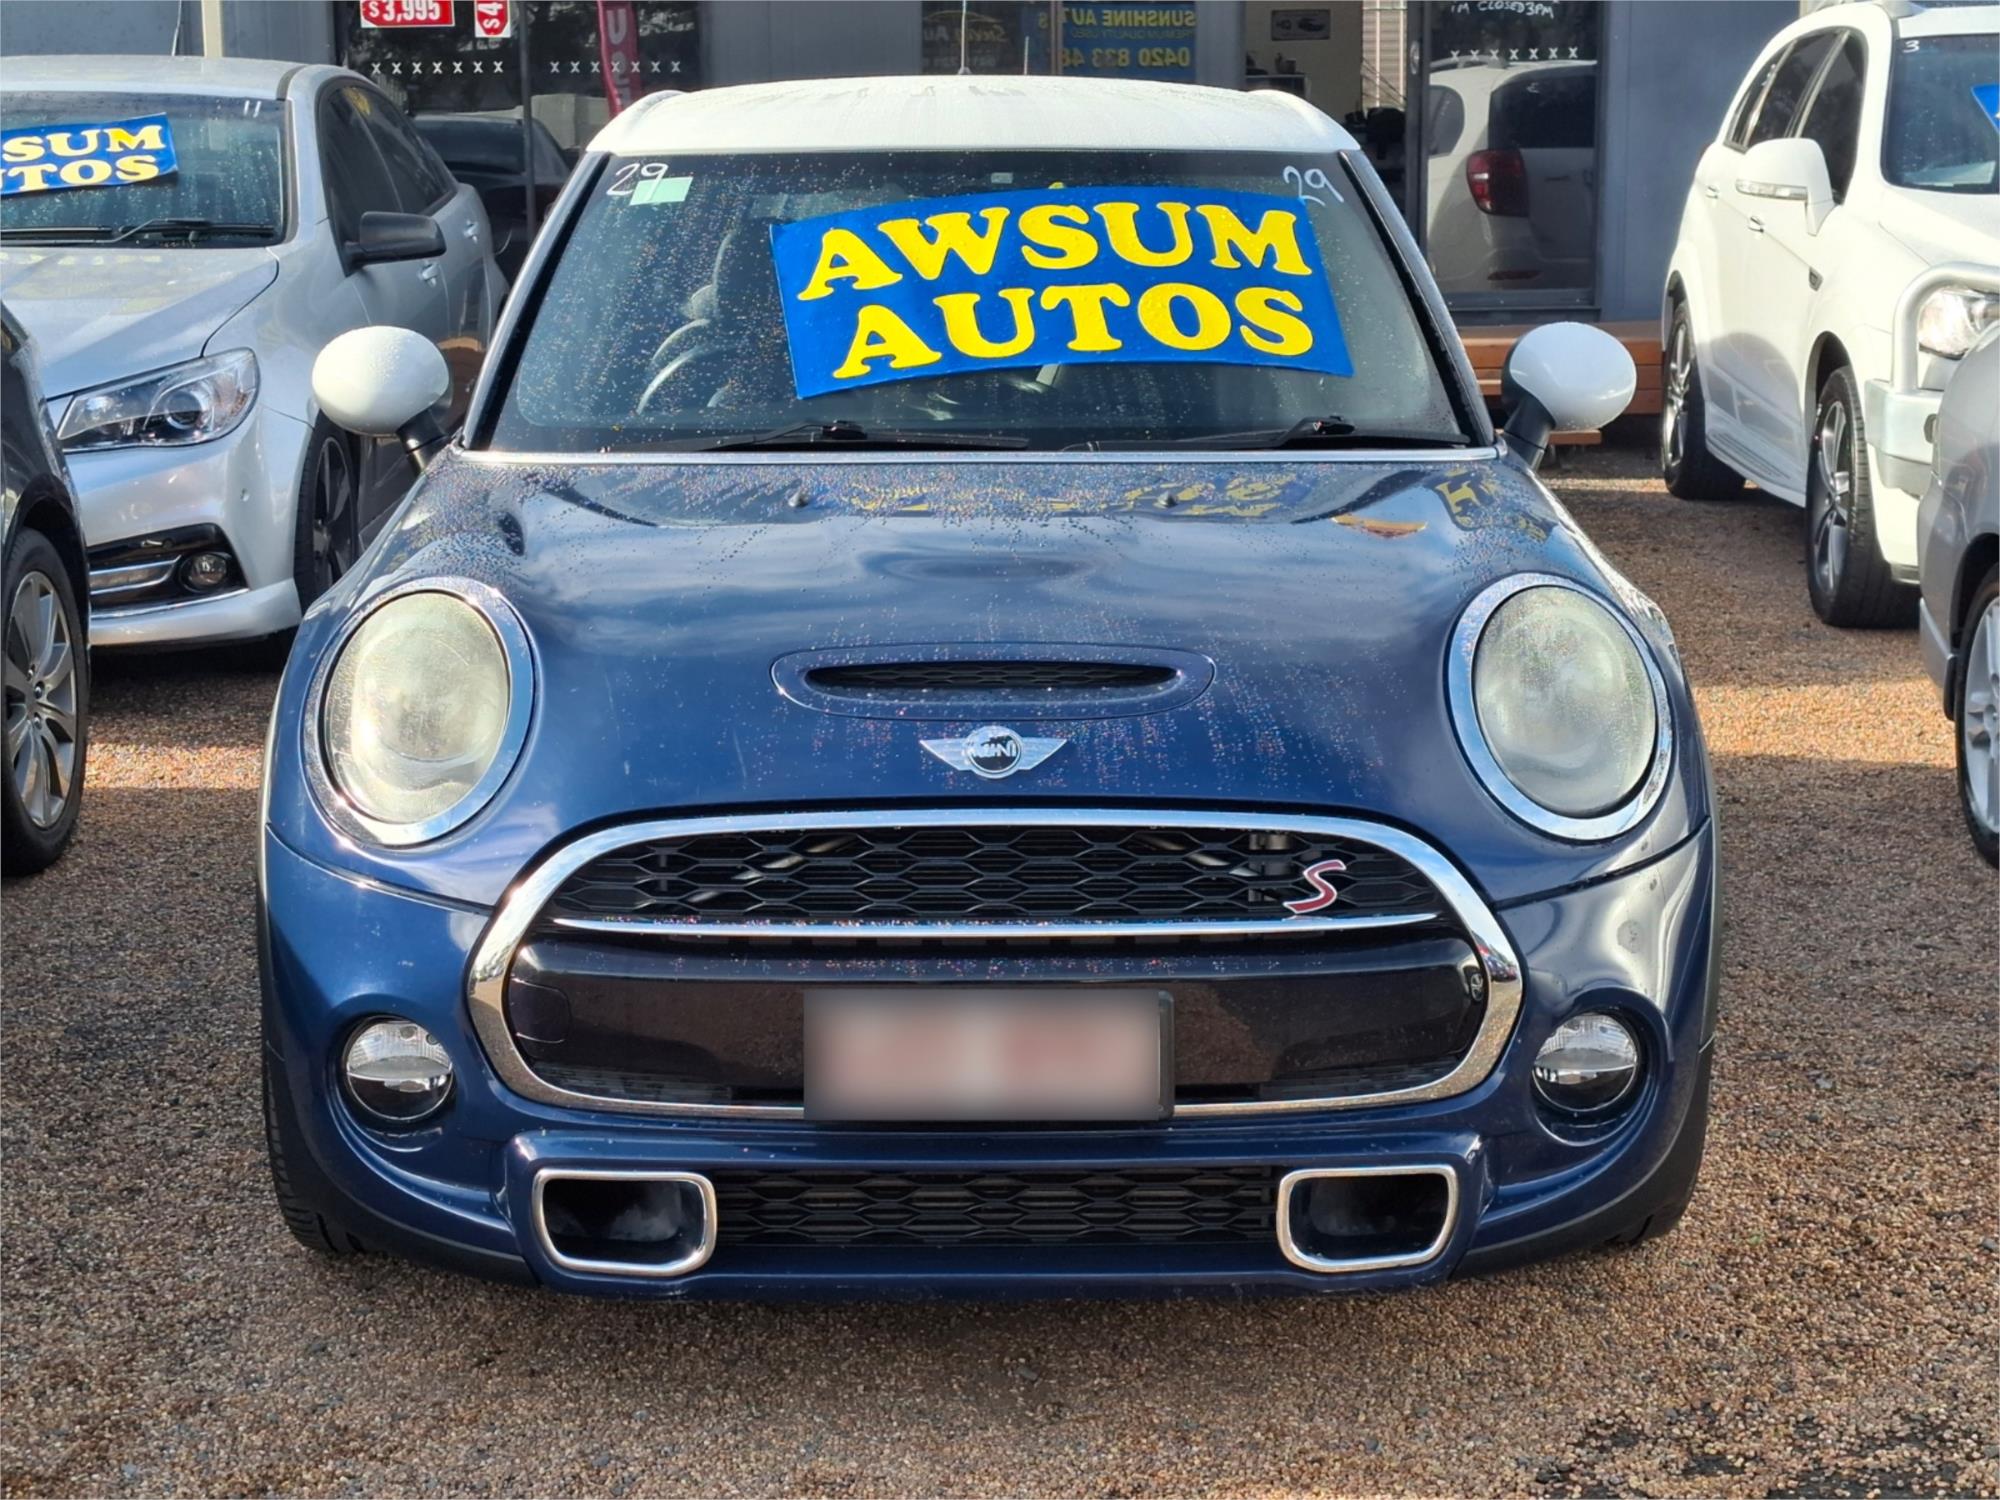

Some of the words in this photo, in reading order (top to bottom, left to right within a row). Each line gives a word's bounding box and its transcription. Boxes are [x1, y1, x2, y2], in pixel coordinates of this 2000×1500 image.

[1903, 40, 1920, 53] 3
[0, 155, 160, 191] TOS
[606, 163, 669, 201] 29
[1283, 166, 1344, 206] 29
[797, 201, 1312, 300] AWSUM
[833, 282, 1313, 379] AUTOS
[1282, 859, 1347, 914] S
